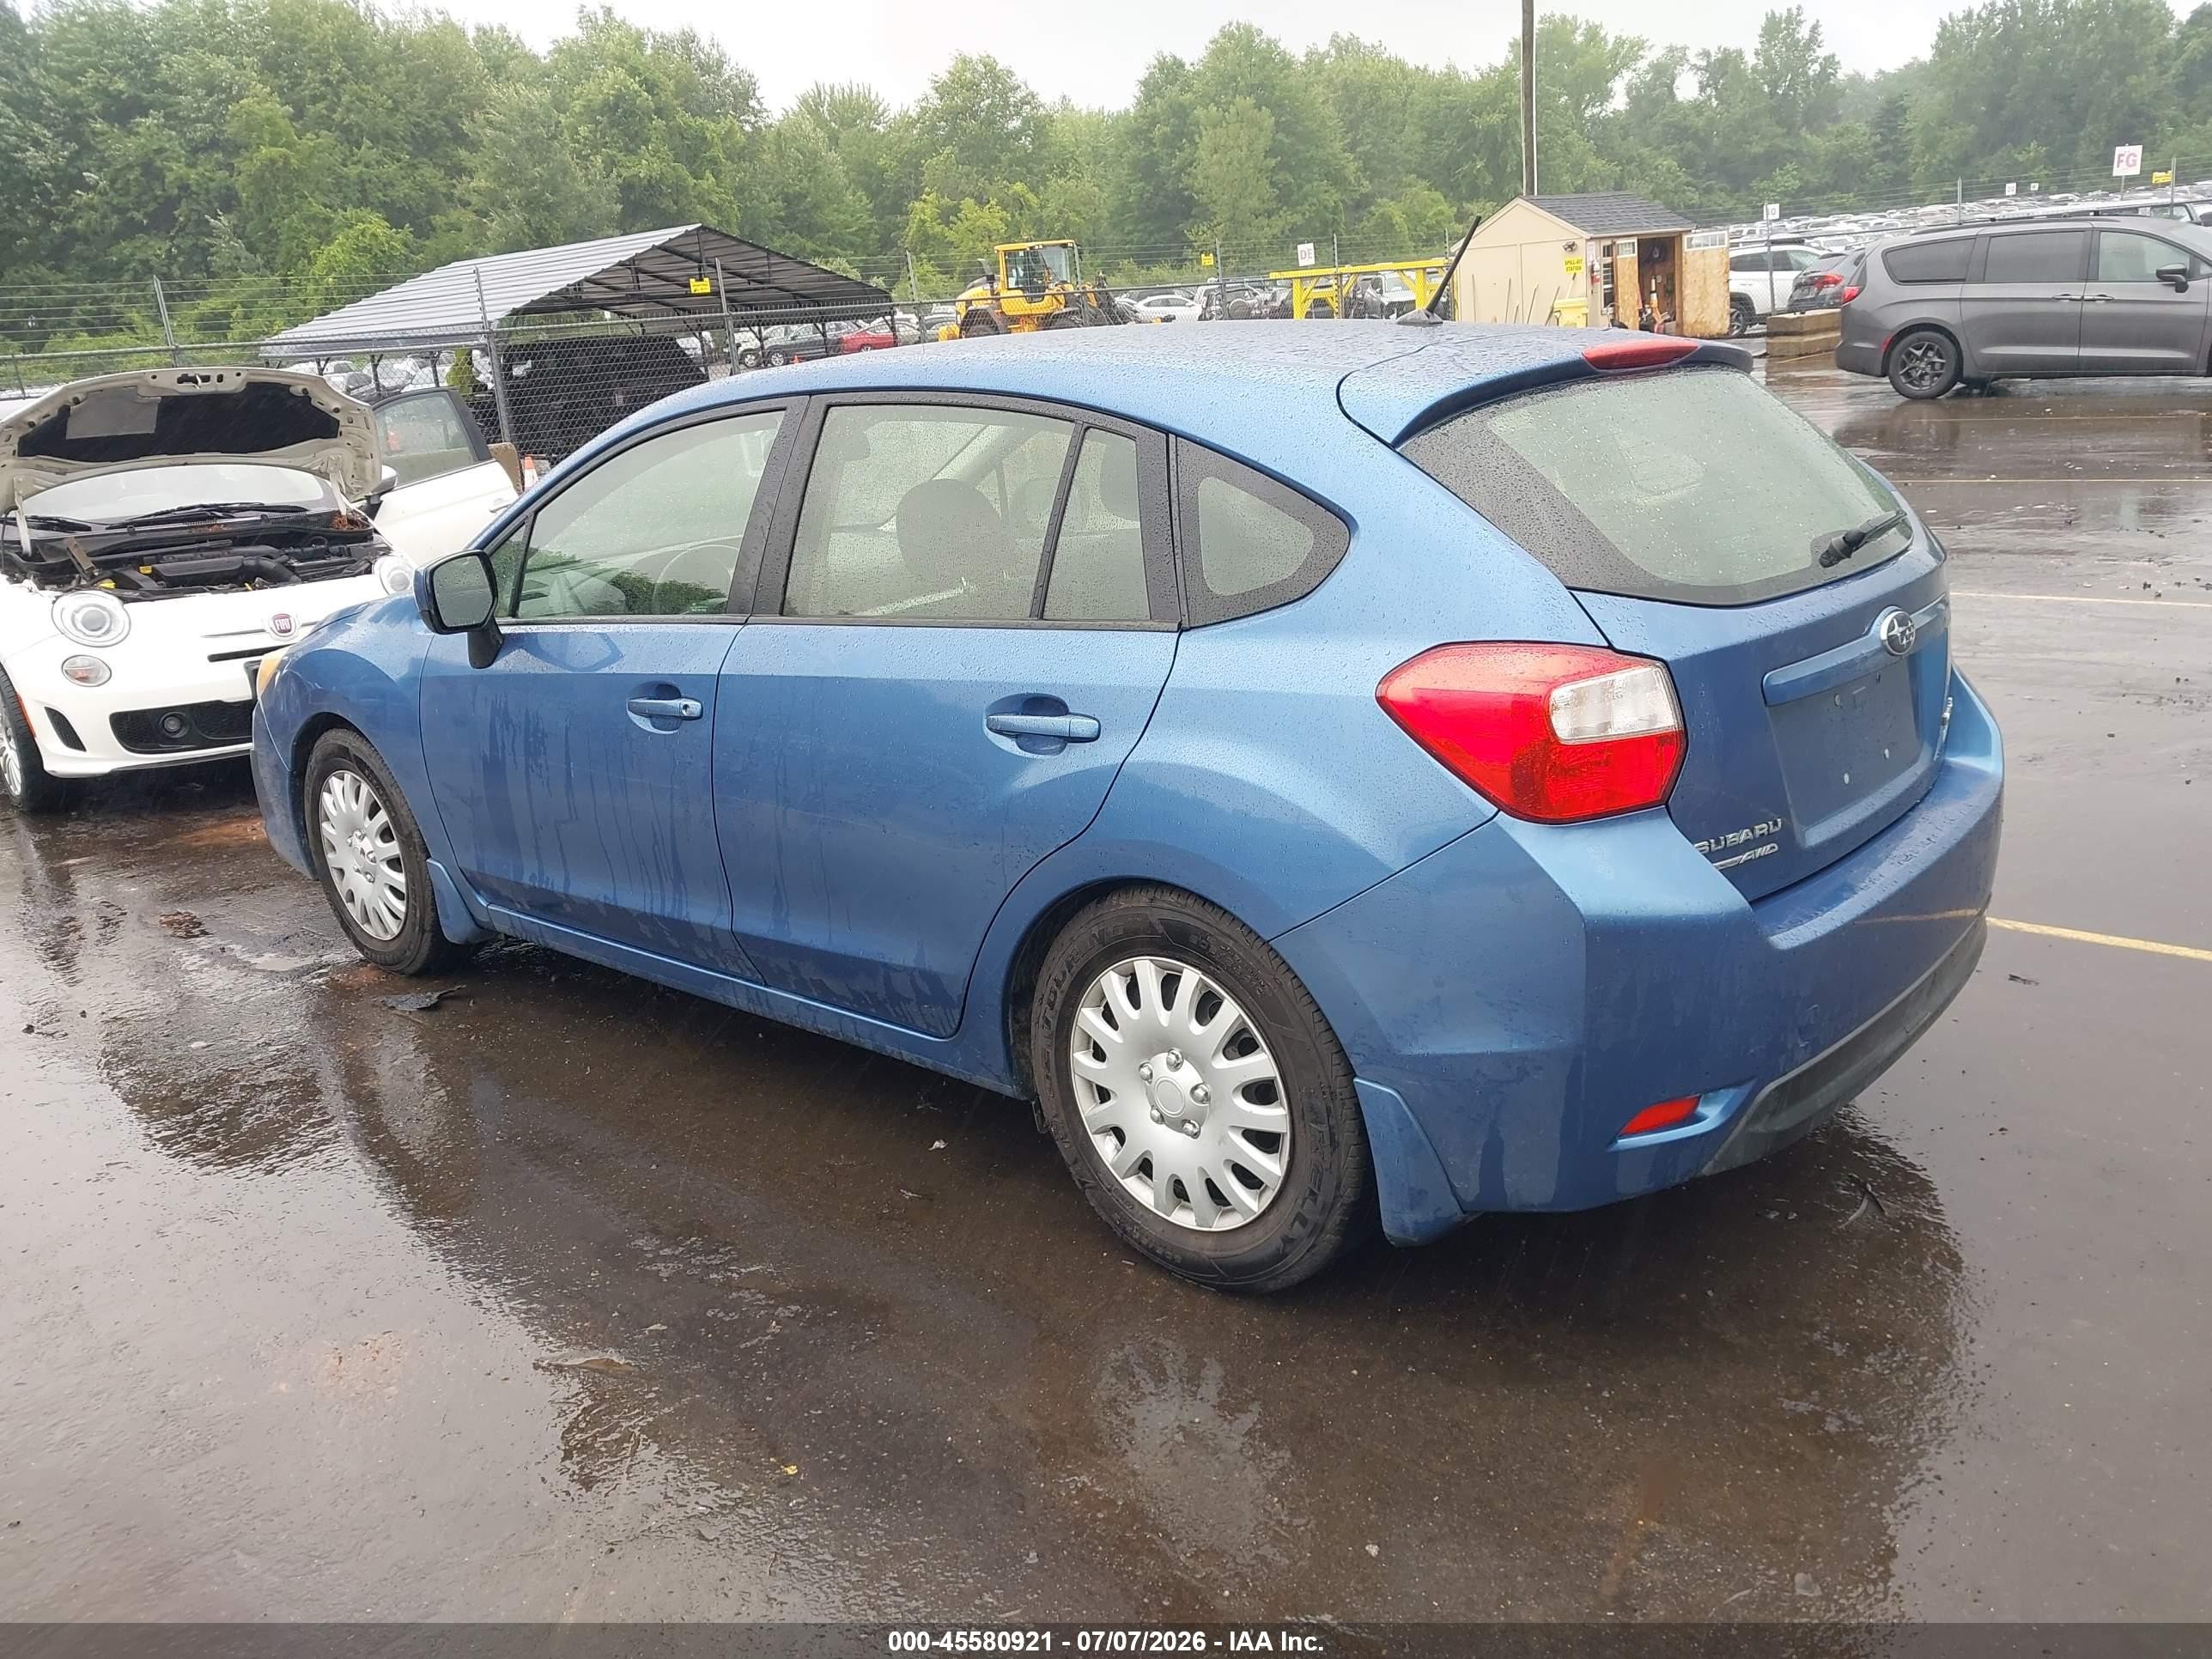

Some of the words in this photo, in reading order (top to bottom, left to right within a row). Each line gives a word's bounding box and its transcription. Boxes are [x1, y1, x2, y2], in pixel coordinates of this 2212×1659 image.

[2117, 153, 2137, 167] FG
[1300, 249, 1313, 259] DE
[1693, 818, 1782, 854] SUBARU
[1740, 842, 1778, 864] AWD
